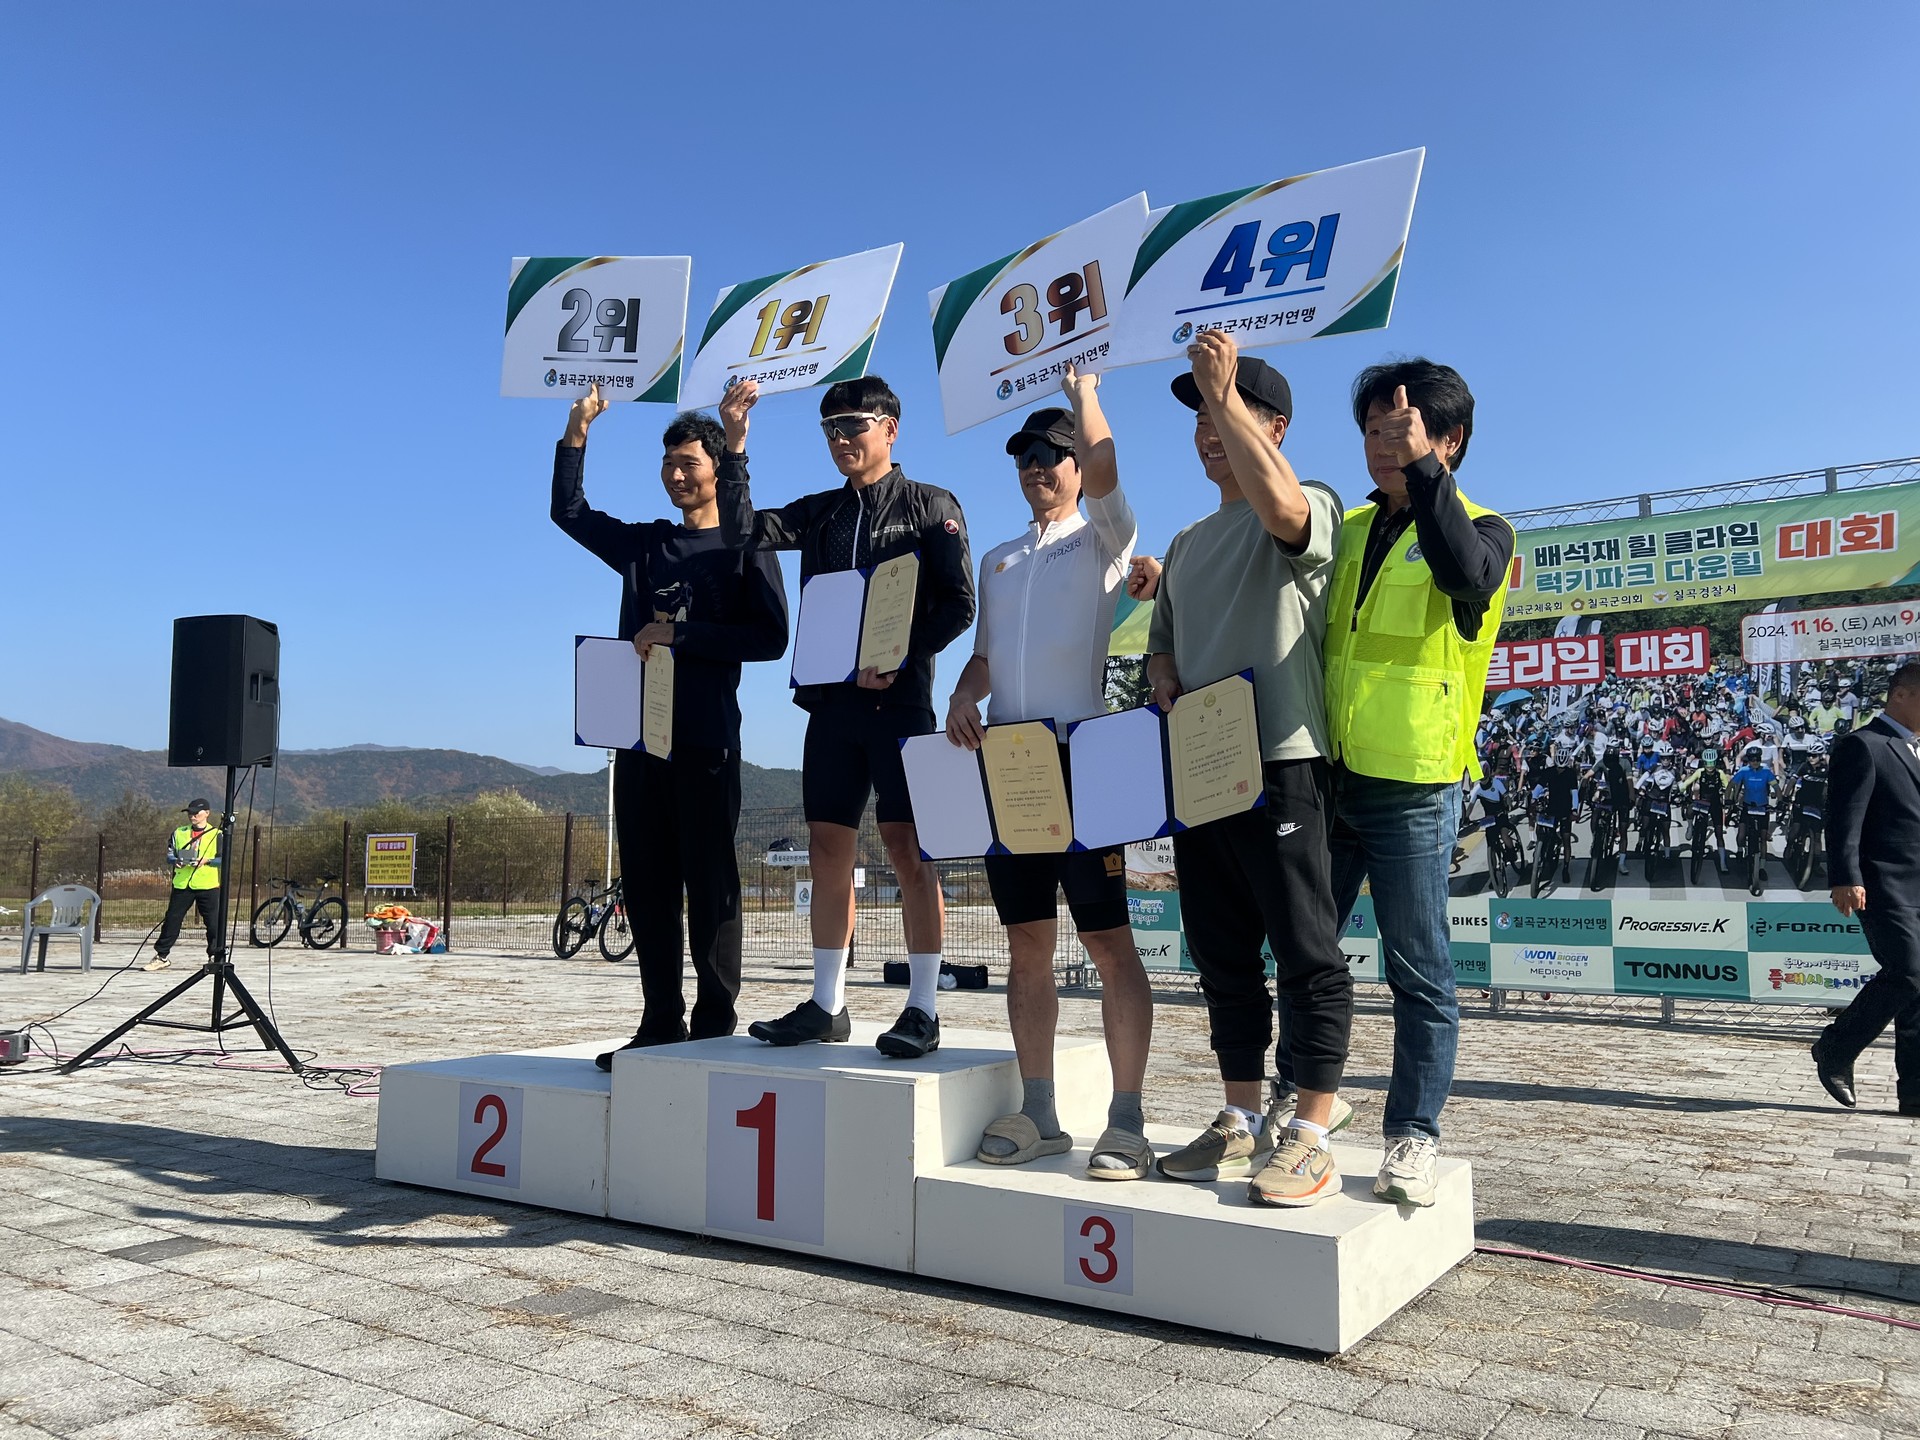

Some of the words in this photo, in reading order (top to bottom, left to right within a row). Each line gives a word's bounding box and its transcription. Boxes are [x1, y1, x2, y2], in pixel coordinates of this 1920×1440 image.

[1200, 213, 1341, 296] 4위
[557, 288, 641, 353] 2위
[1000, 259, 1108, 356] 3위
[748, 294, 831, 358] 1위
[1534, 538, 1621, 567] 배석재
[1628, 534, 1657, 559] 힐
[1664, 521, 1760, 555] 클라임
[1779, 512, 1896, 560] 대회
[1536, 562, 1656, 594] 럭키파크
[1664, 550, 1763, 582] 다운힐
[1588, 594, 1643, 609] 칠곡군의회
[1673, 583, 1737, 601] 칠곡경찰서
[1506, 601, 1564, 617] 칠곡군체육회
[1841, 616, 1868, 632] (토)
[1872, 615, 1897, 629] AM
[1619, 631, 1704, 673] 대회
[1818, 631, 1920, 651] 칠곡보야외물놀이
[1280, 822, 1296, 831] NIKE
[1127, 898, 1141, 907] ON
[1452, 916, 1488, 927] BIKES
[1513, 916, 1608, 930] 칠곡군자전거연맹
[1524, 950, 1557, 960] WON
[1557, 954, 1589, 962] BIOGEN
[1530, 968, 1582, 977] MEDISORB
[470, 1093, 508, 1177] 2
[735, 1091, 777, 1222] 1
[1078, 1215, 1118, 1283] 3
